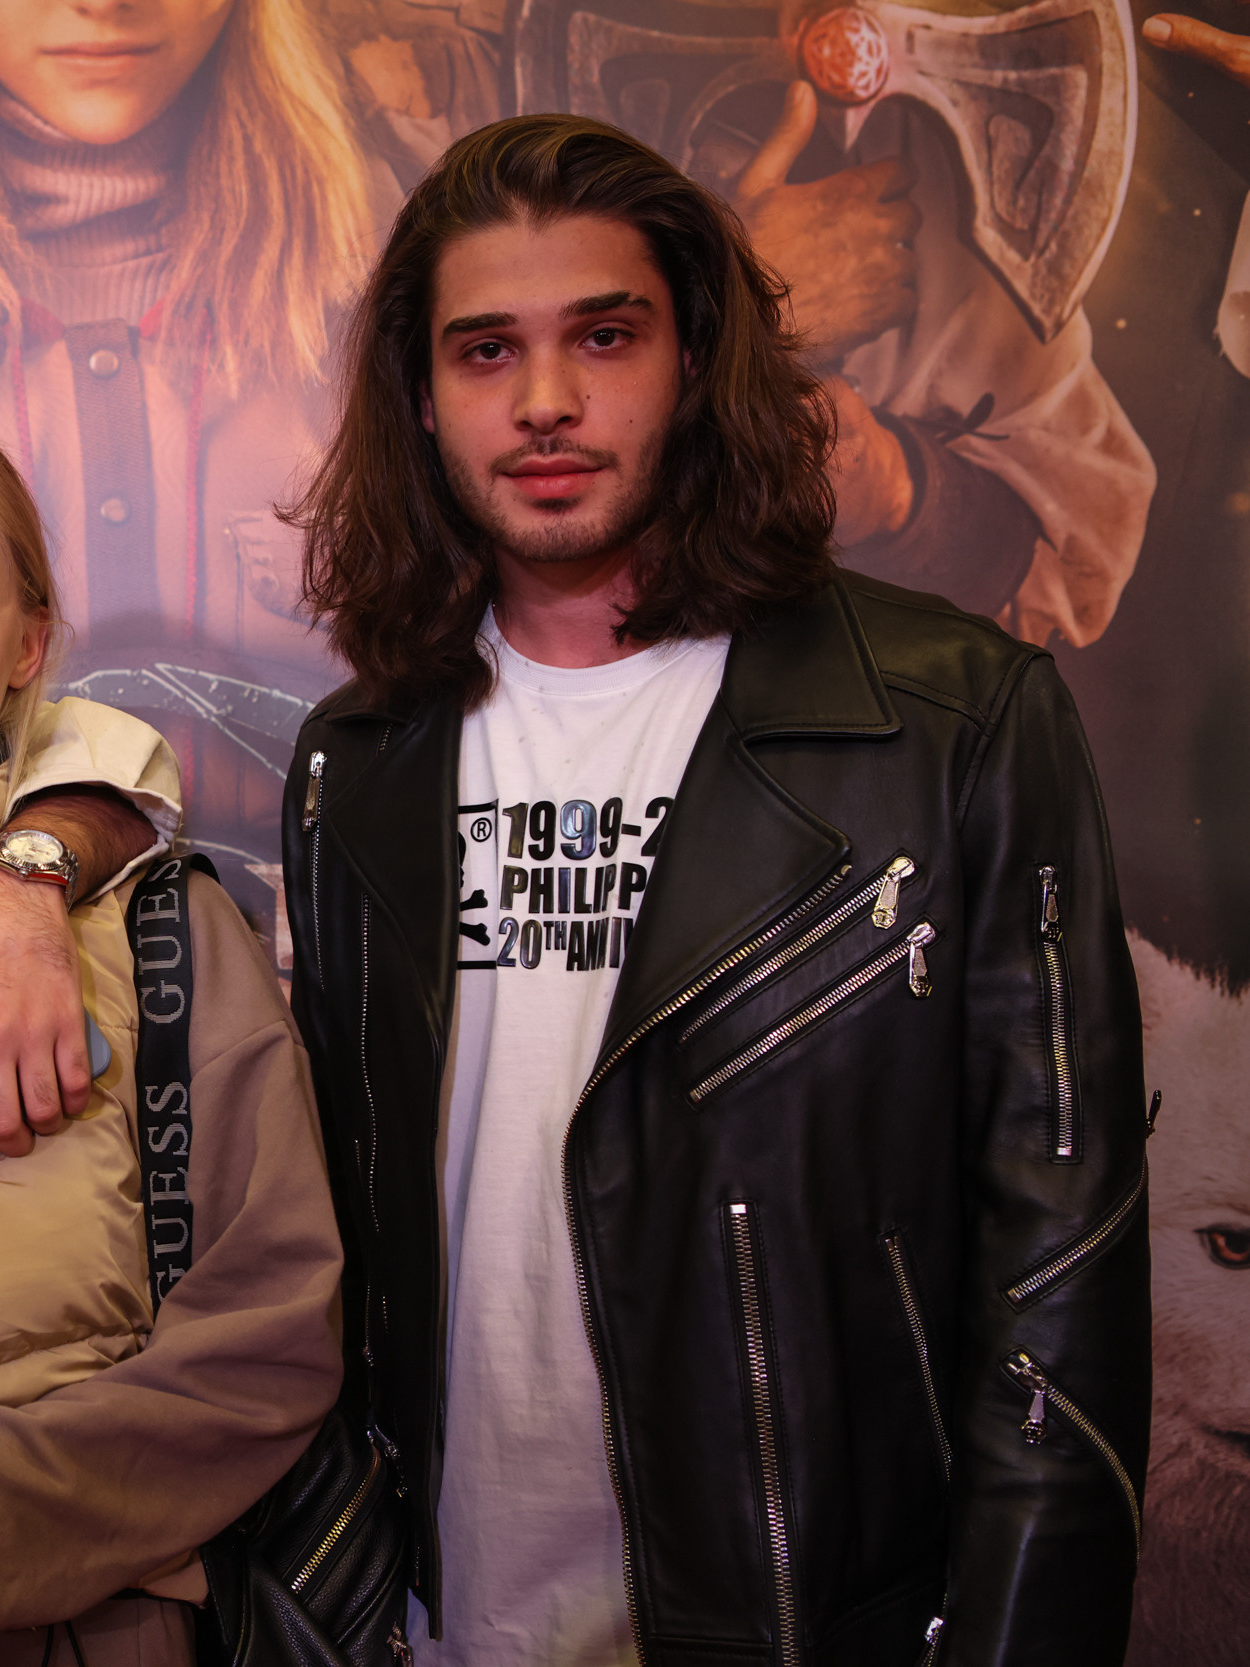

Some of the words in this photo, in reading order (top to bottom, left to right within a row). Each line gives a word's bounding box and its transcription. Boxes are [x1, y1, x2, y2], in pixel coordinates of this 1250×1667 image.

[502, 797, 675, 861] 1999-2
[499, 862, 647, 914] PHILIPP
[136, 859, 185, 1024] GUES
